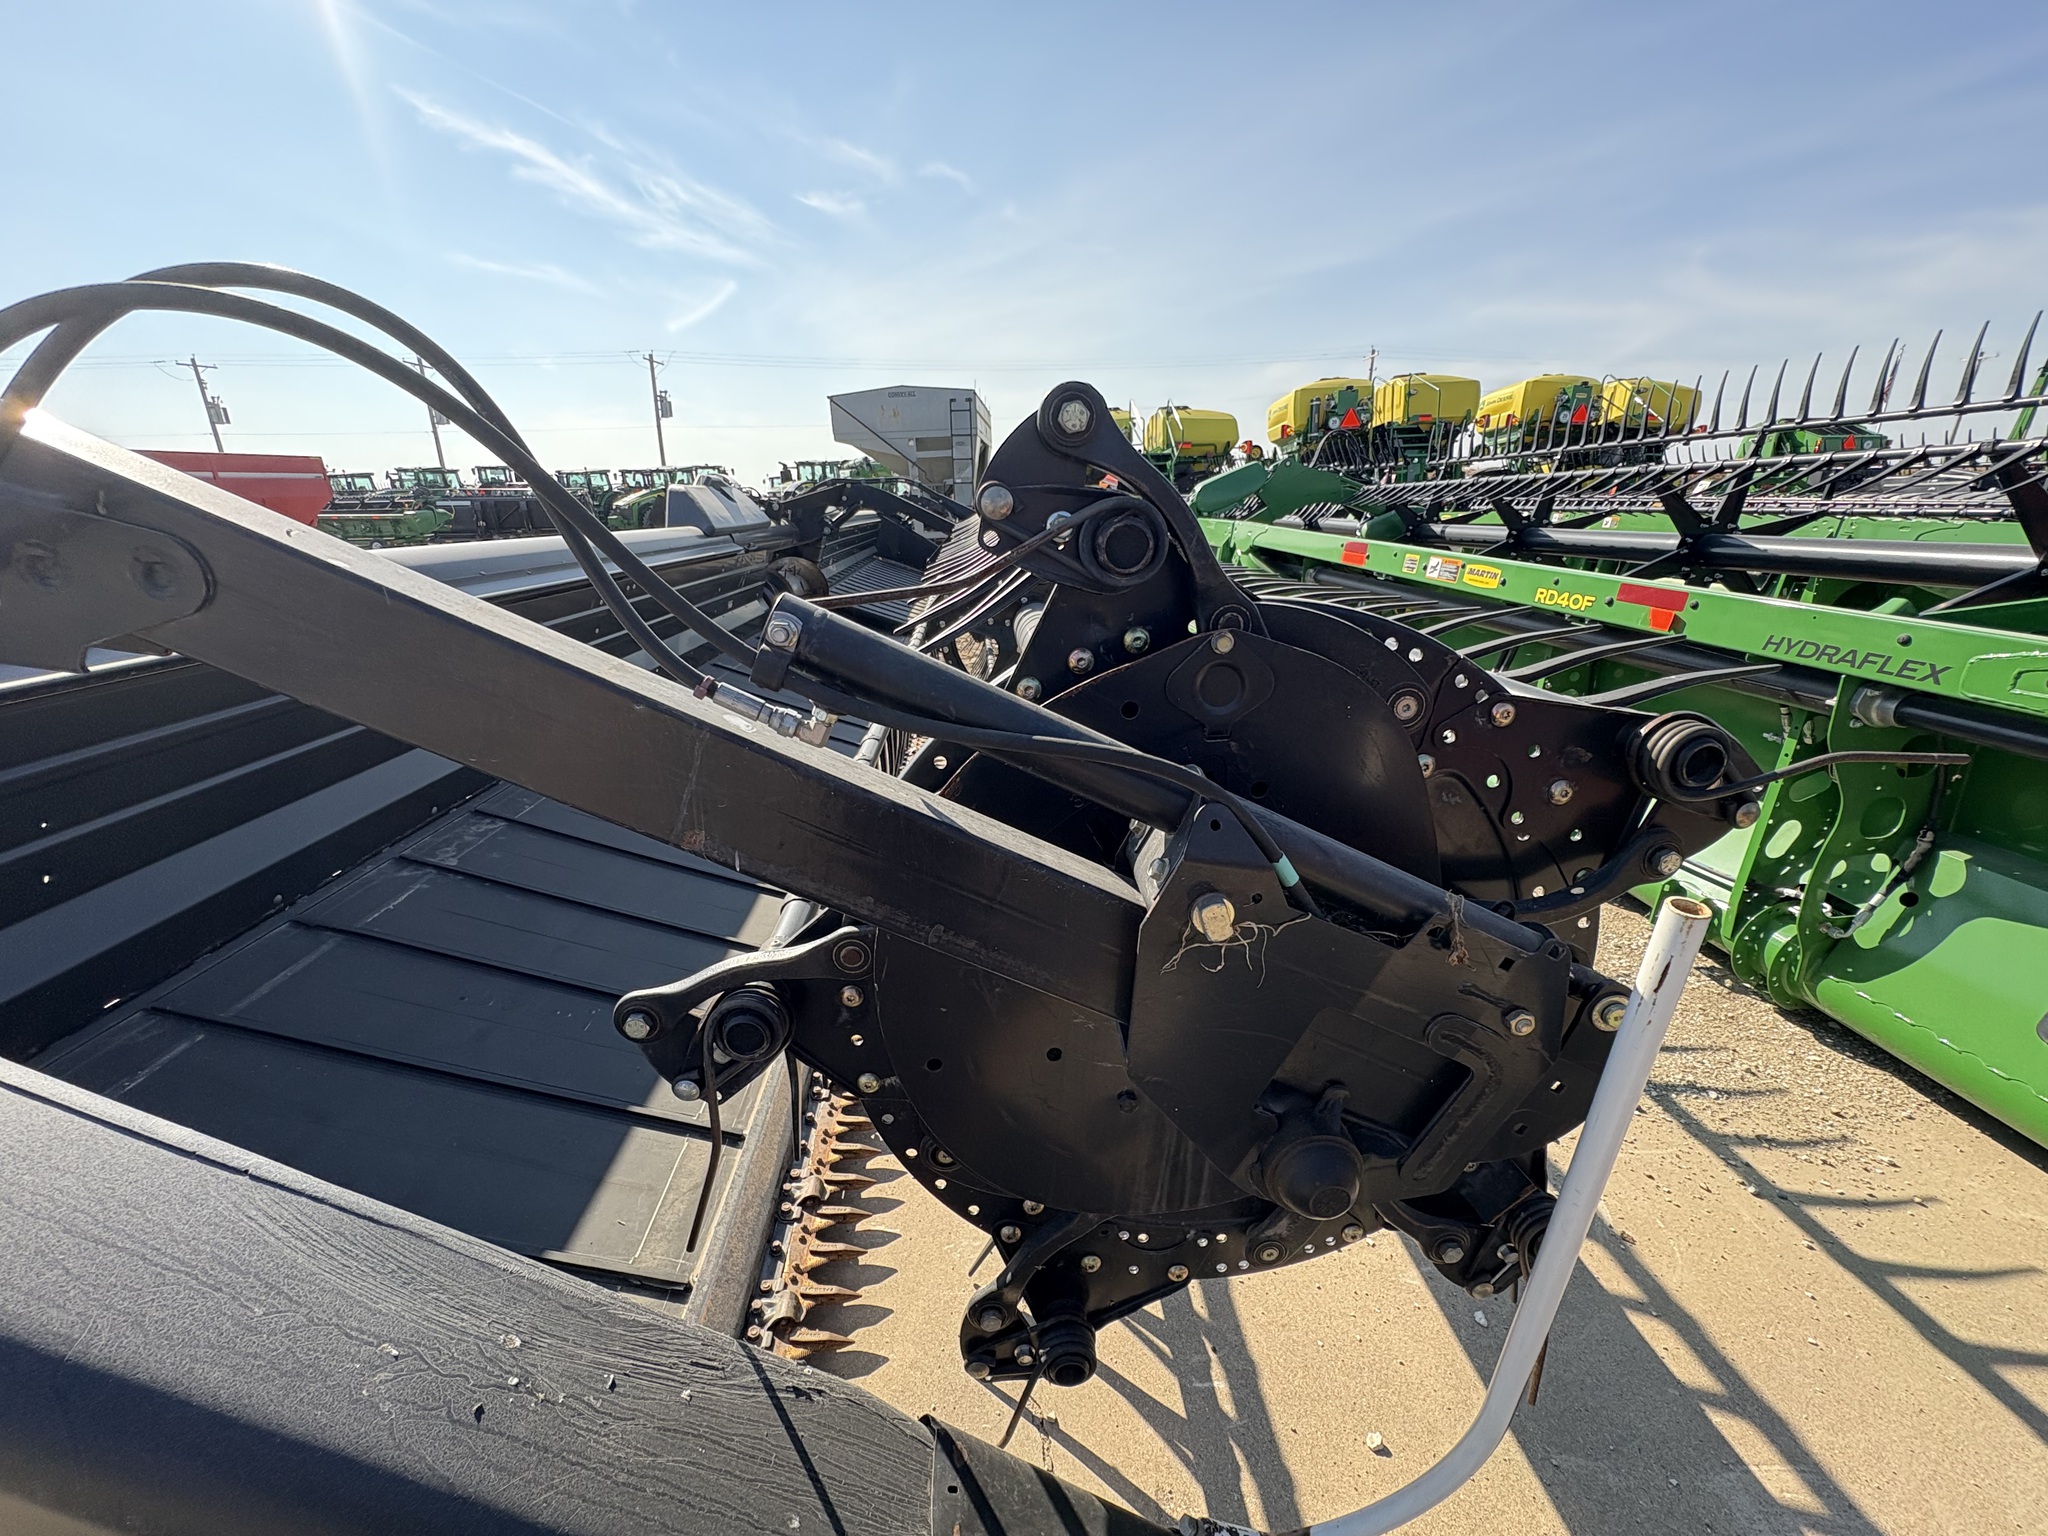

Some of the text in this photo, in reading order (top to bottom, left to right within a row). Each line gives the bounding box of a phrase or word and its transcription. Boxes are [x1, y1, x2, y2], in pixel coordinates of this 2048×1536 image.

[1466, 568, 1499, 581] MARTIN
[1533, 586, 1597, 612] RD40F
[1761, 634, 1954, 686] HYDRAFLEX
